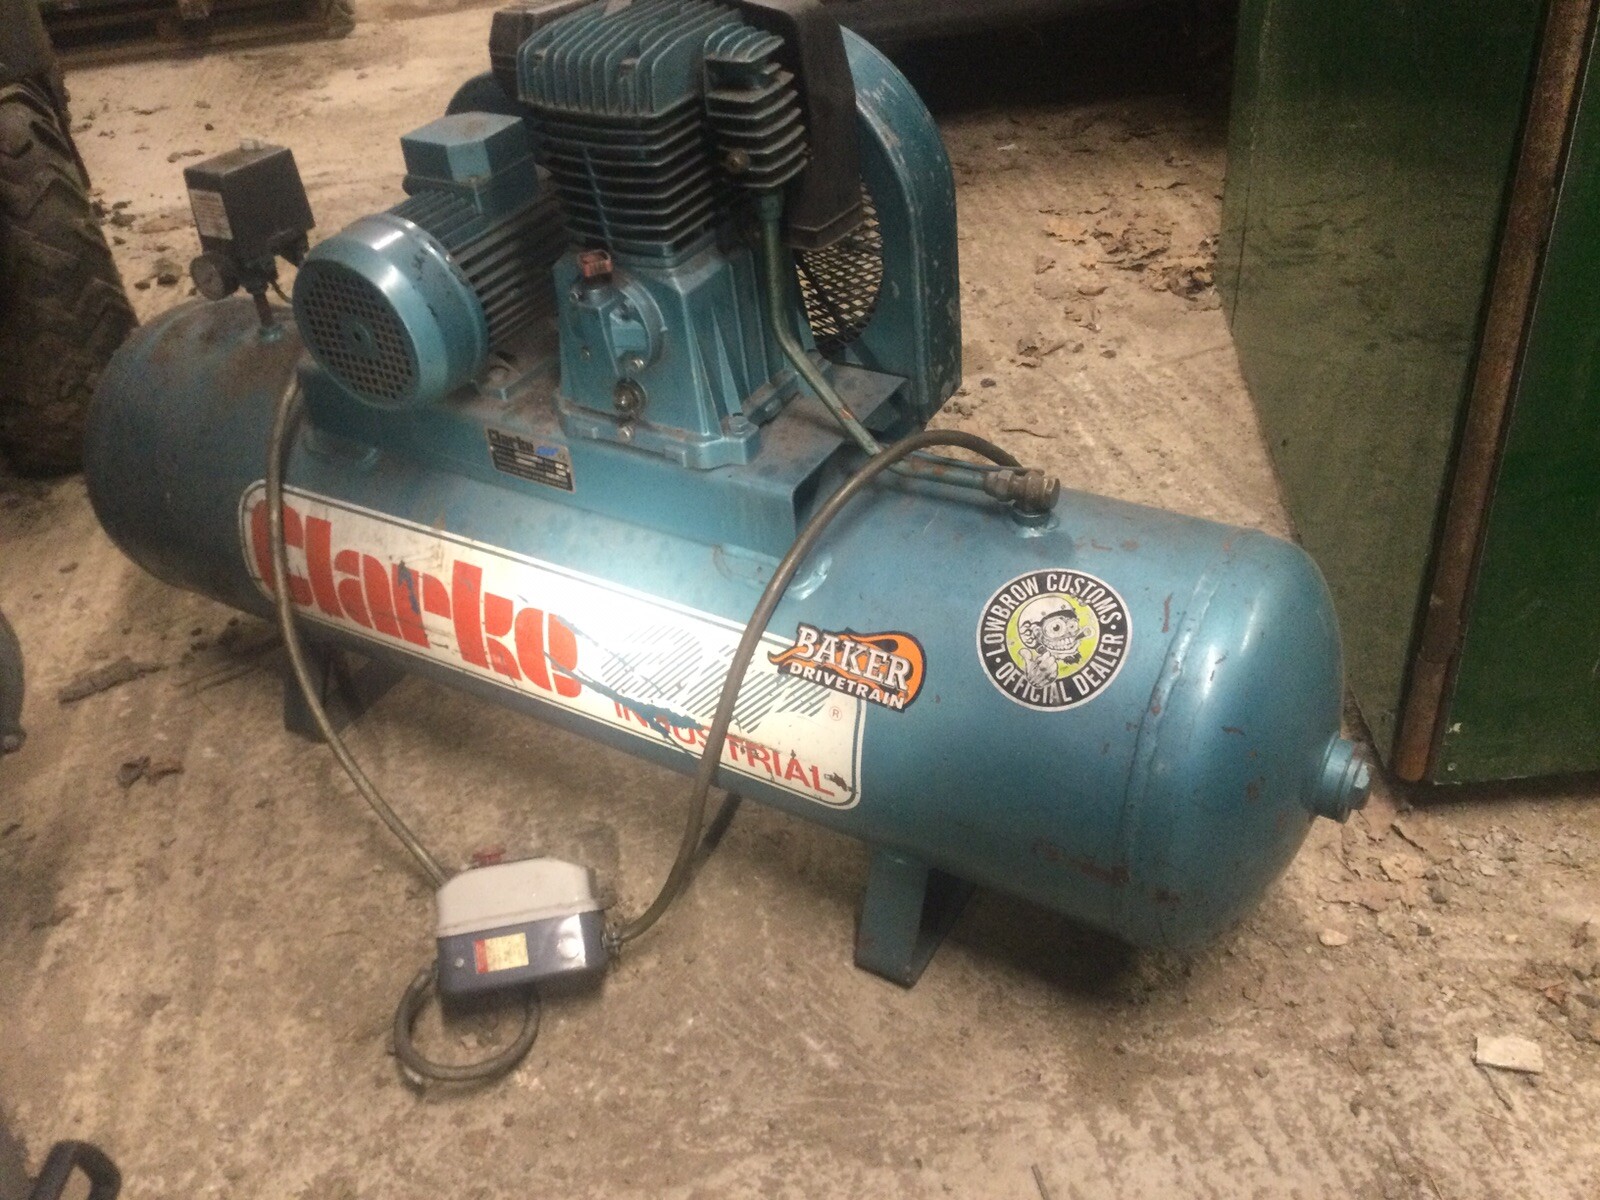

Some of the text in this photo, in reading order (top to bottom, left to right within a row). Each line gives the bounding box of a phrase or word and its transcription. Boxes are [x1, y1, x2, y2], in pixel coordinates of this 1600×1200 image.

[251, 499, 582, 698] Clarke
[983, 574, 1122, 657] LOWBROW CUSTOMS
[789, 661, 905, 710] DRIVETRAIN
[793, 626, 908, 691] BAKER
[995, 634, 1124, 704] OFFICIAL DEALER
